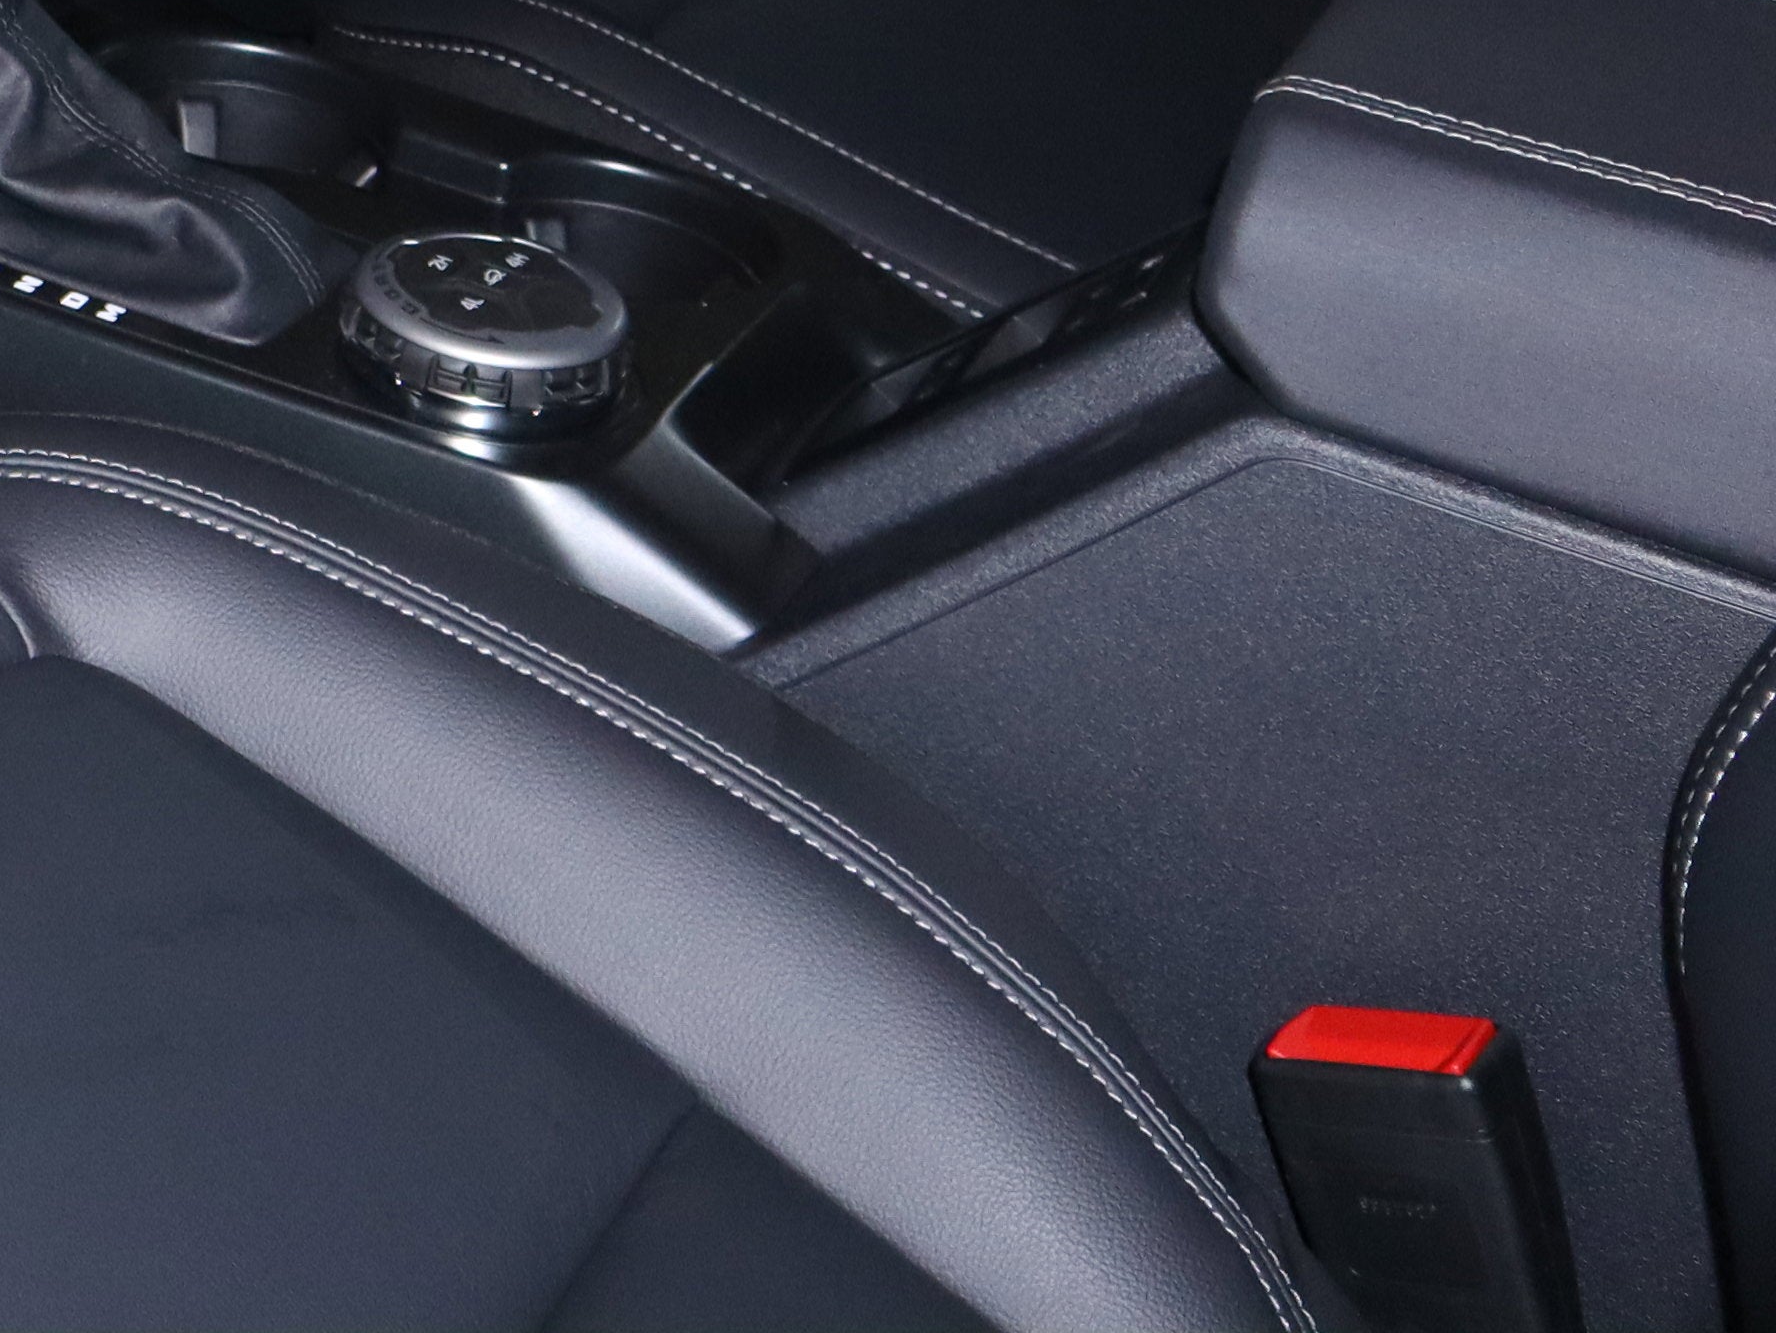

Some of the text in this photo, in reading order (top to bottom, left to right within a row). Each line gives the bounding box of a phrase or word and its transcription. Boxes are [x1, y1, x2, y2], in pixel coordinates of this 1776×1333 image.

[428, 254, 453, 272] 2H
[13, 275, 44, 293] N
[96, 303, 127, 323] M
